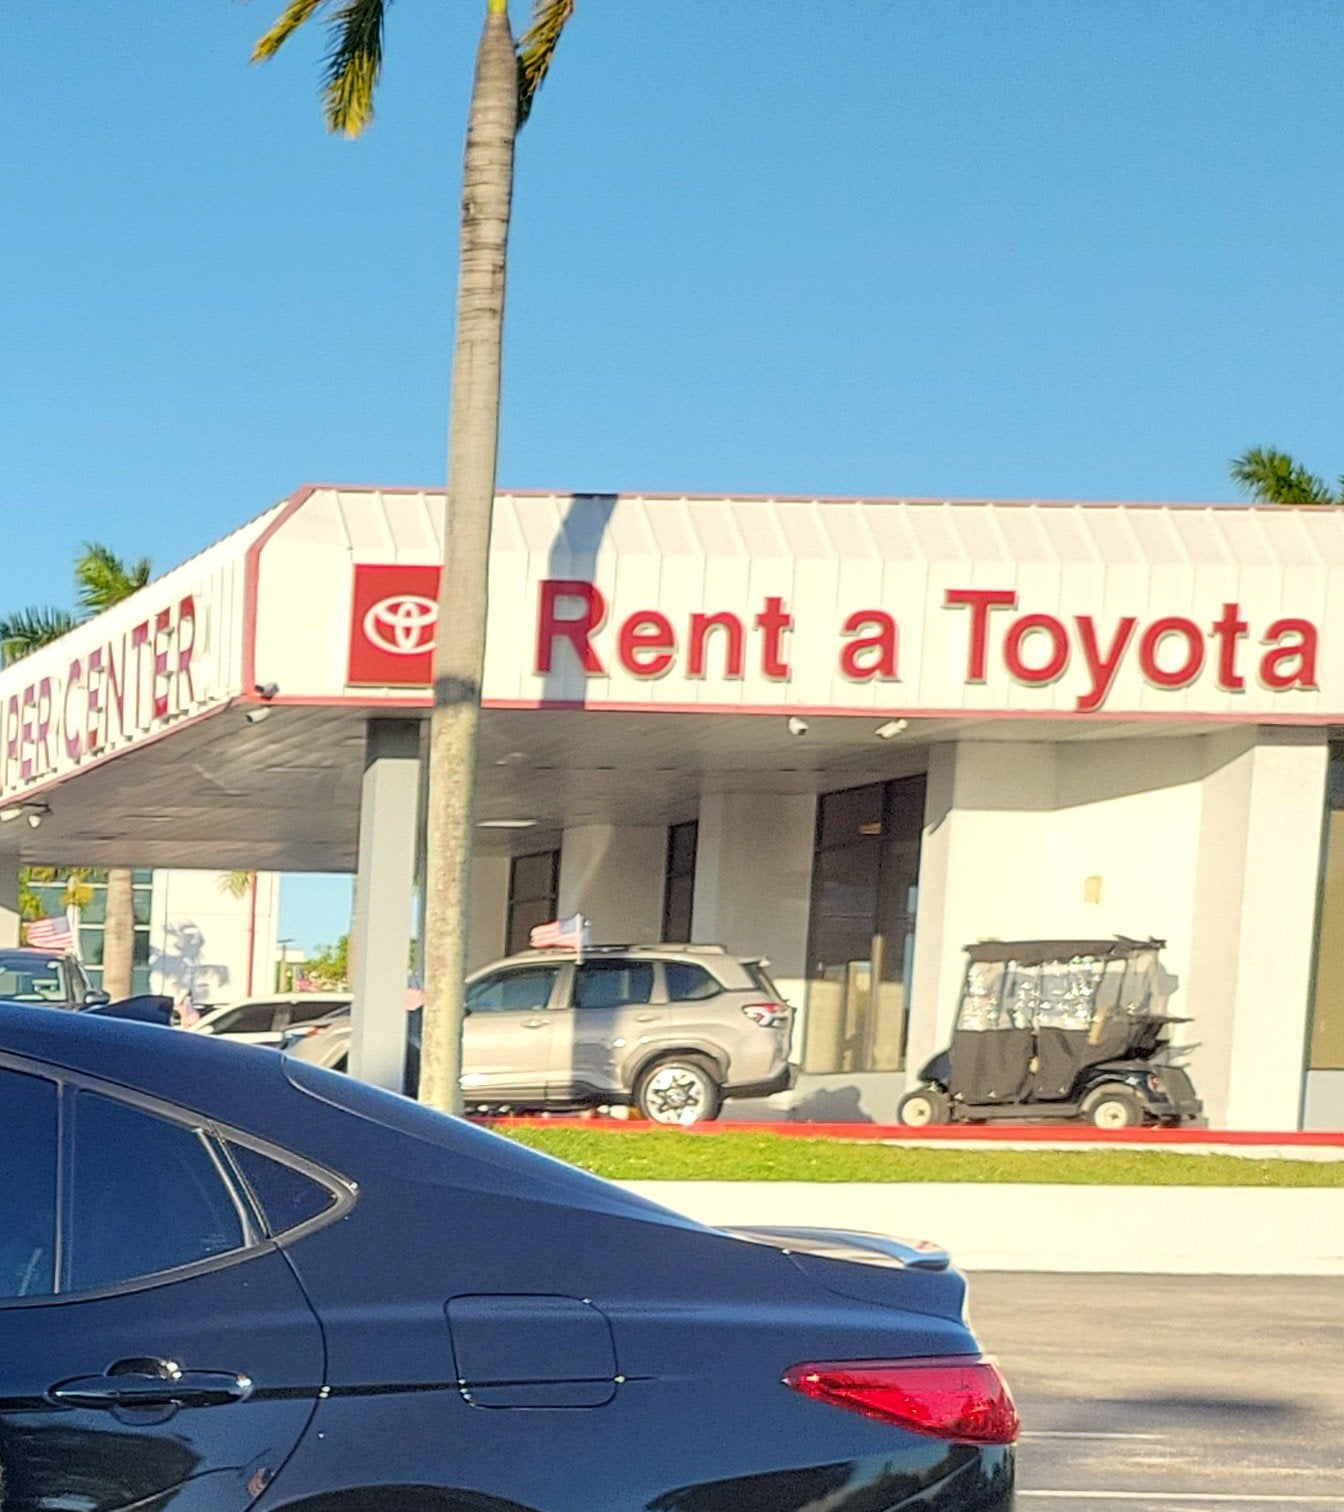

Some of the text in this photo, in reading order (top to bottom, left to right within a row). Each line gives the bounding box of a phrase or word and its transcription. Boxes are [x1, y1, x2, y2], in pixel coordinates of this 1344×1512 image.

[63, 594, 196, 759] CENTER
[535, 579, 1321, 713] Rent a Toyota
